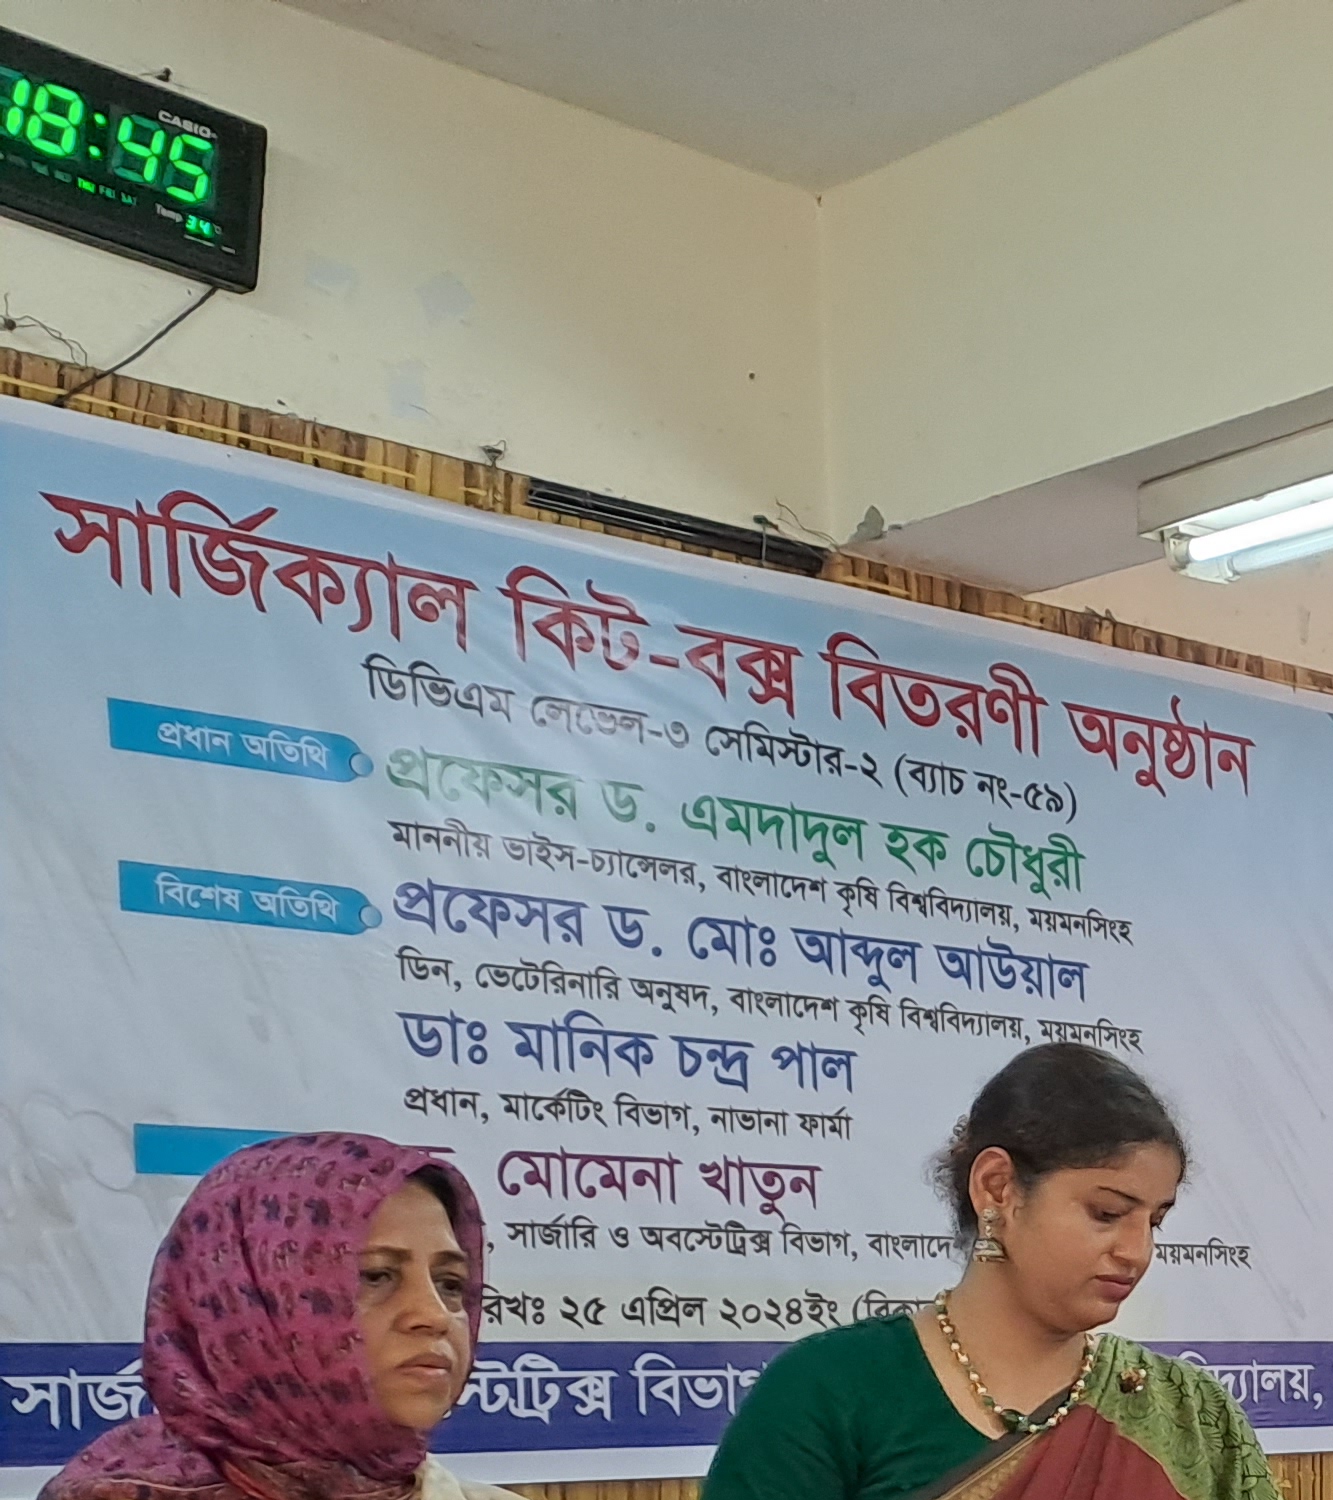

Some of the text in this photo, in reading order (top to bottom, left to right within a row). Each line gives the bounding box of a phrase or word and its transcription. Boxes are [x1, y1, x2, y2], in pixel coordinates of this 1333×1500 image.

[158, 109, 218, 140] CASIO
[39, 489, 1255, 796] সার্জিক্যাল কিট-বক্স বিতরণী অনুষ্ঠান
[157, 720, 330, 770] প্রধান অতিথি
[360, 653, 1077, 824] ডিভিএম লেভেল-৩ সেমিস্টার-২ (ব্যাচ নং-৫৯)
[386, 746, 1086, 898] প্রফেসর ড. এমদাদুল হক চৌধুরী
[155, 871, 341, 924] বিশেষ অতিথি
[387, 818, 493, 860] মাননীয়
[713, 864, 830, 903] বাংলাদেশ
[833, 876, 879, 918] কৃষি
[1026, 906, 1135, 946] ময়মনসিংহ
[393, 877, 1089, 1002] প্রফেসর ড. মোঃ আব্দুল আউয়াল
[394, 945, 462, 992] ডিন,
[475, 957, 622, 1001] ভেটেরিনারি
[628, 977, 719, 1017] অনুষদ,
[727, 985, 839, 1023] বাংলাদেশ
[845, 995, 891, 1035] কৃষি
[395, 1009, 859, 1094] ডাঃ মানিক চন্দ্র পাল
[403, 1086, 854, 1140] প্রধান, মার্কেটিং বিভাগ, নাভানা ফার্মা
[497, 1145, 824, 1223] মোমেনা খাতুন
[504, 1213, 599, 1251] সার্জারি
[608, 1226, 630, 1249] ও
[779, 1222, 858, 1262] বিভাগ,
[865, 1230, 955, 1260] বাংলাদে
[560, 1295, 607, 1329] ২৫
[621, 1285, 708, 1328] এপ্রিল
[719, 1288, 841, 1331] ২০২৪ইং
